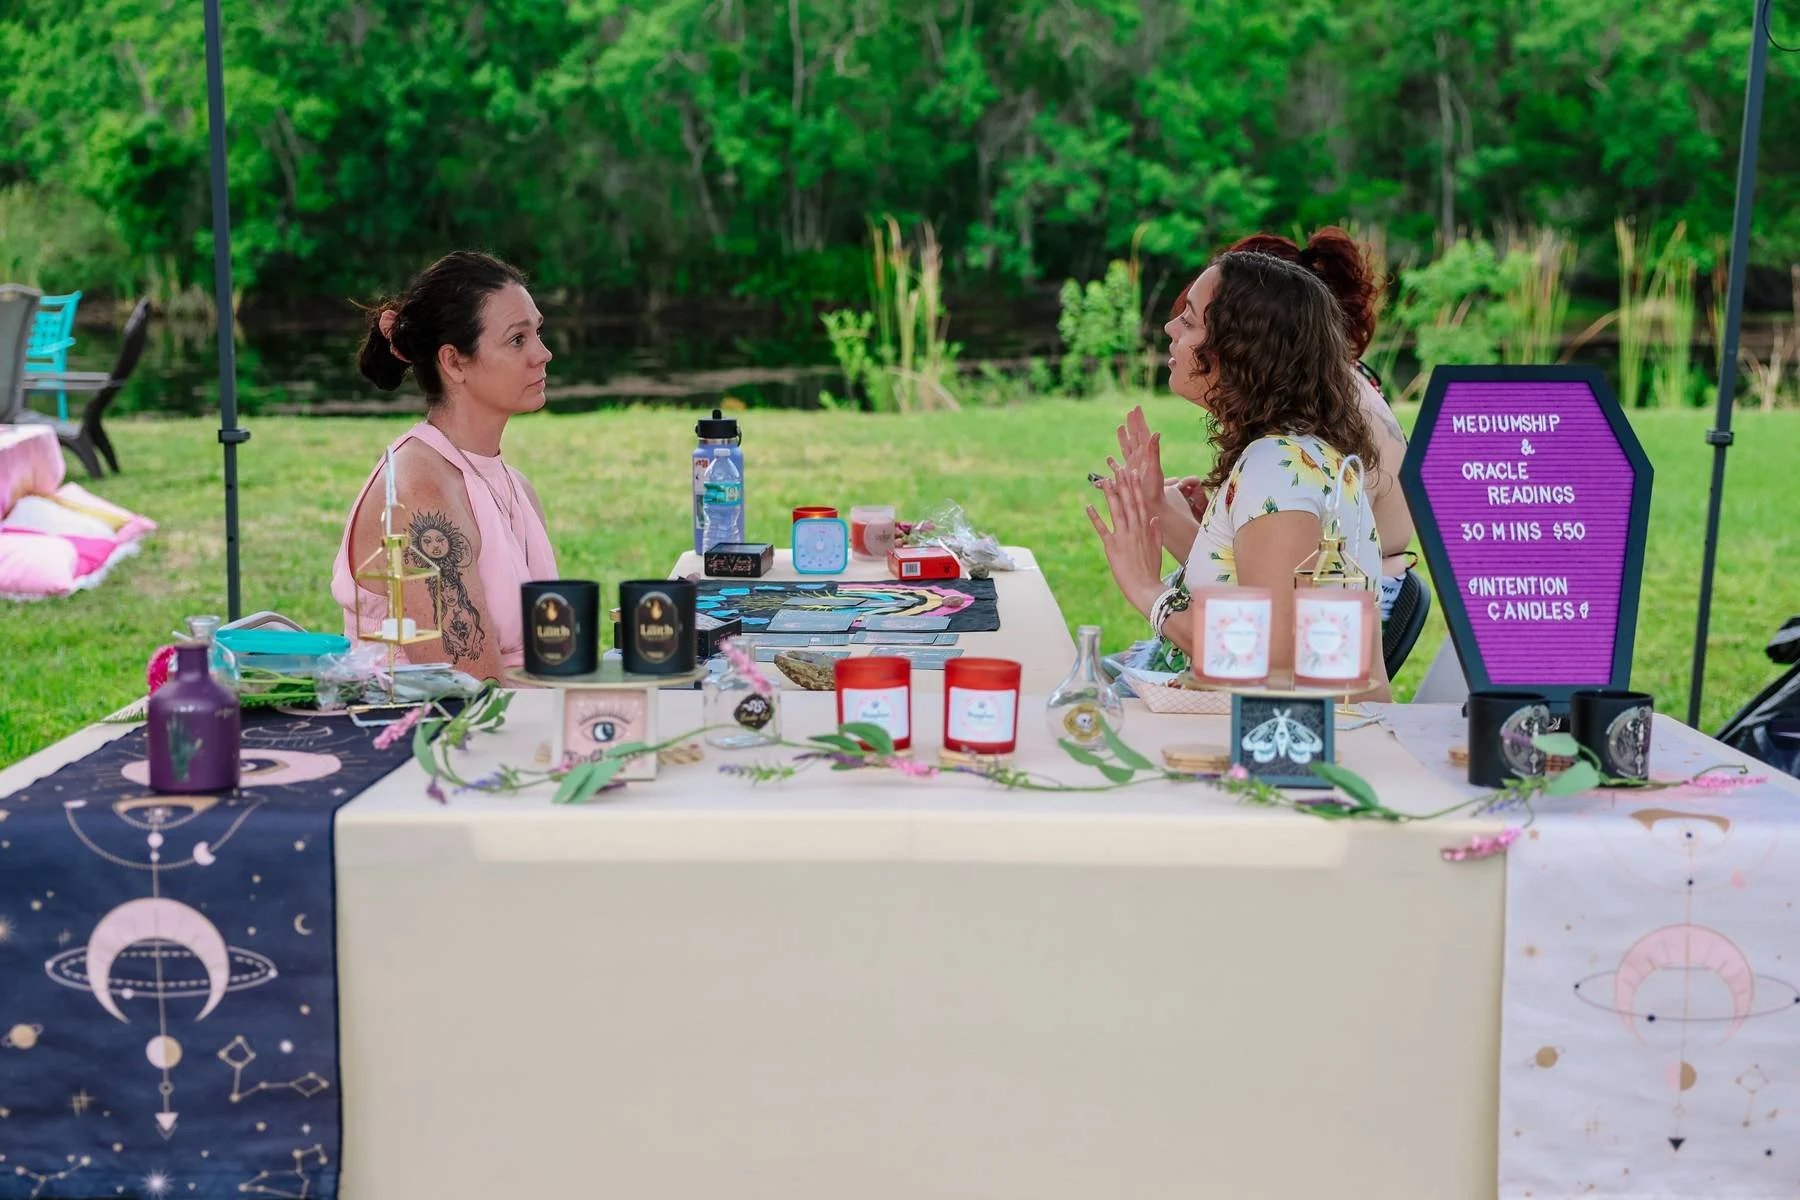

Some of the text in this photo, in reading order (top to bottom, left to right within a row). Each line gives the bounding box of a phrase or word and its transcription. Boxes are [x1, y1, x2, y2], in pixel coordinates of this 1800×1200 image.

[1453, 414, 1561, 433] MEDIUMSHIP
[1520, 438, 1536, 455] &
[1462, 461, 1529, 480] ORACLE
[1488, 486, 1575, 505] READINGS
[1461, 522, 1586, 541] 30 MINS $50
[1480, 576, 1567, 596] INTENTION
[1488, 602, 1575, 621] CANDLES
